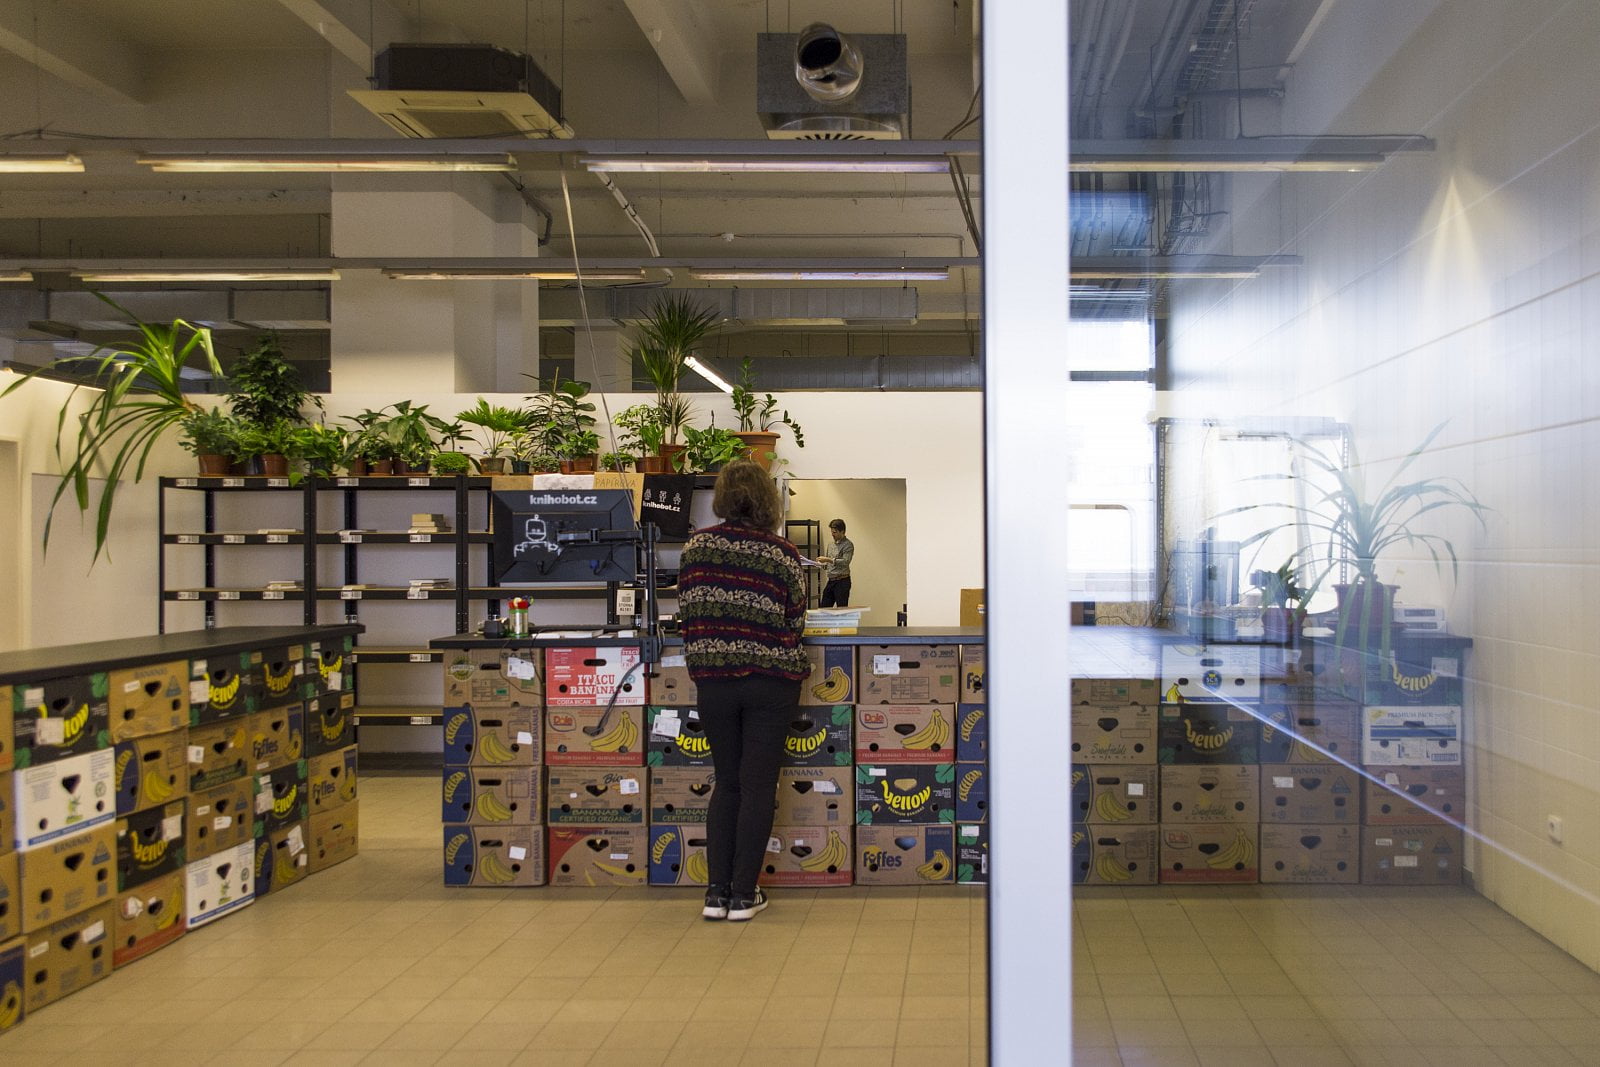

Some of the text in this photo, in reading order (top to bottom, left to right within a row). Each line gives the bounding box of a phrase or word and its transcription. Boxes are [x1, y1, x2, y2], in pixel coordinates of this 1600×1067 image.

[529, 494, 597, 505] knihobot.cz
[642, 500, 680, 512] knihobot.cz
[577, 674, 616, 686] ITACU
[553, 716, 573, 724] Dole
[864, 714, 884, 722] Dole
[1184, 719, 1234, 749] yellow
[881, 780, 931, 810] yellow
[863, 852, 902, 870] fyffes
